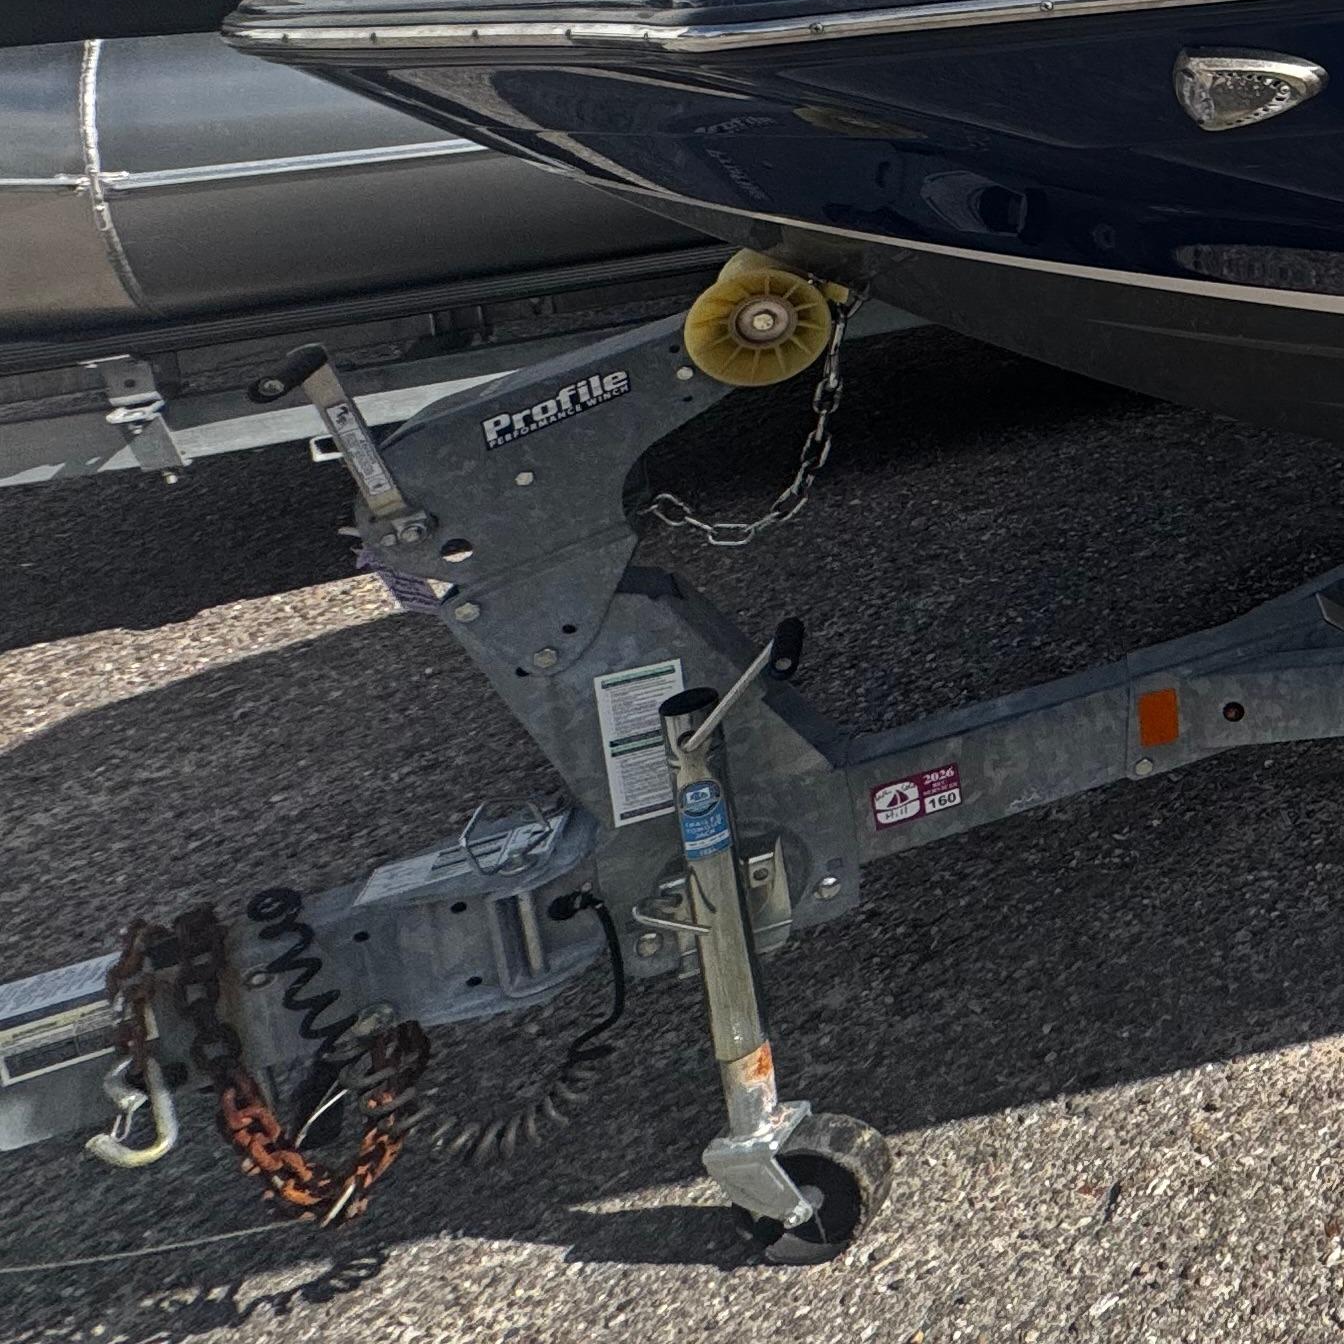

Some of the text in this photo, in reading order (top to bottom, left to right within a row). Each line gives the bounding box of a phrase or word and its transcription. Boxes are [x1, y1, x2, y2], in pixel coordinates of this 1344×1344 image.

[482, 370, 629, 442] Profile
[489, 384, 630, 448] PERFORMANCE WINCH
[927, 792, 957, 809] 160
